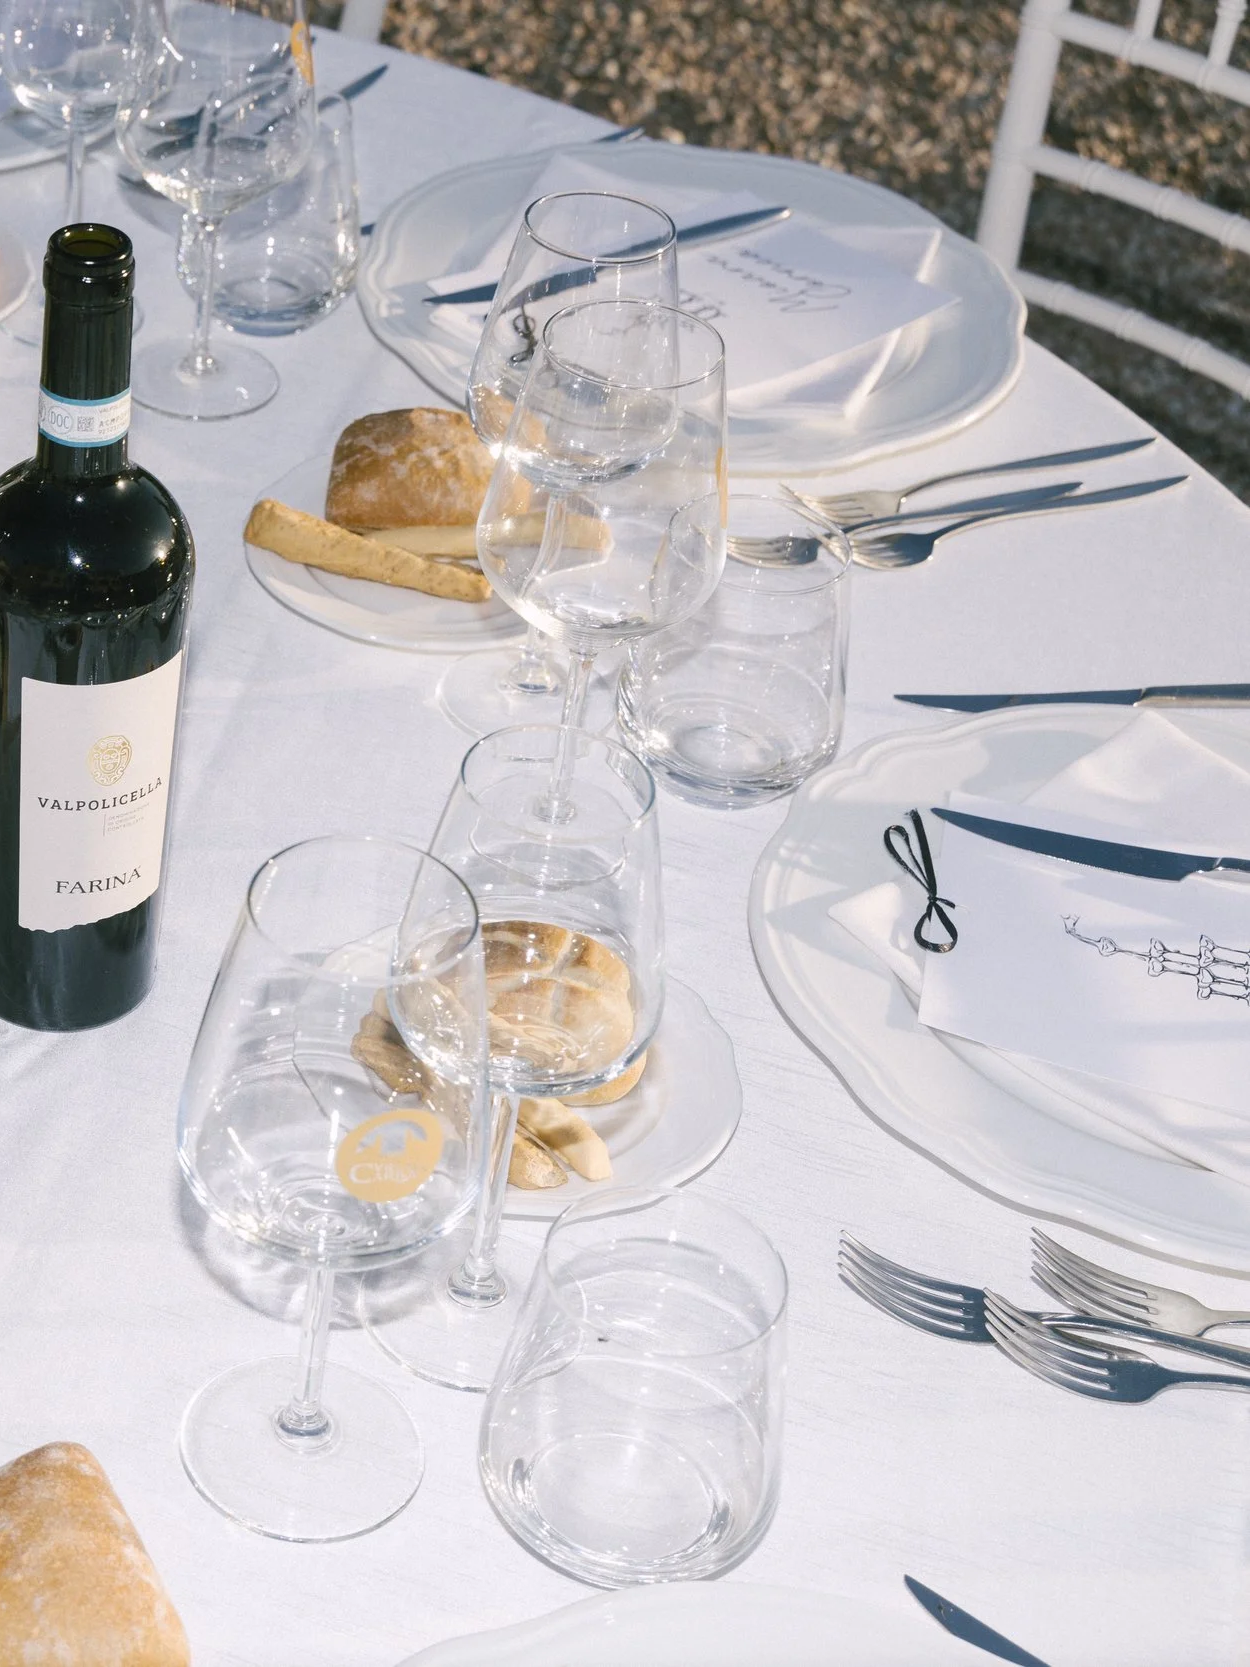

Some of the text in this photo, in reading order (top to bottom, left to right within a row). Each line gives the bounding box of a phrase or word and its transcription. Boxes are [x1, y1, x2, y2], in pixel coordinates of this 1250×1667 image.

[50, 411, 70, 430] DOC
[37, 777, 162, 811] VALPOLICELLA
[55, 867, 141, 894] FARINA
